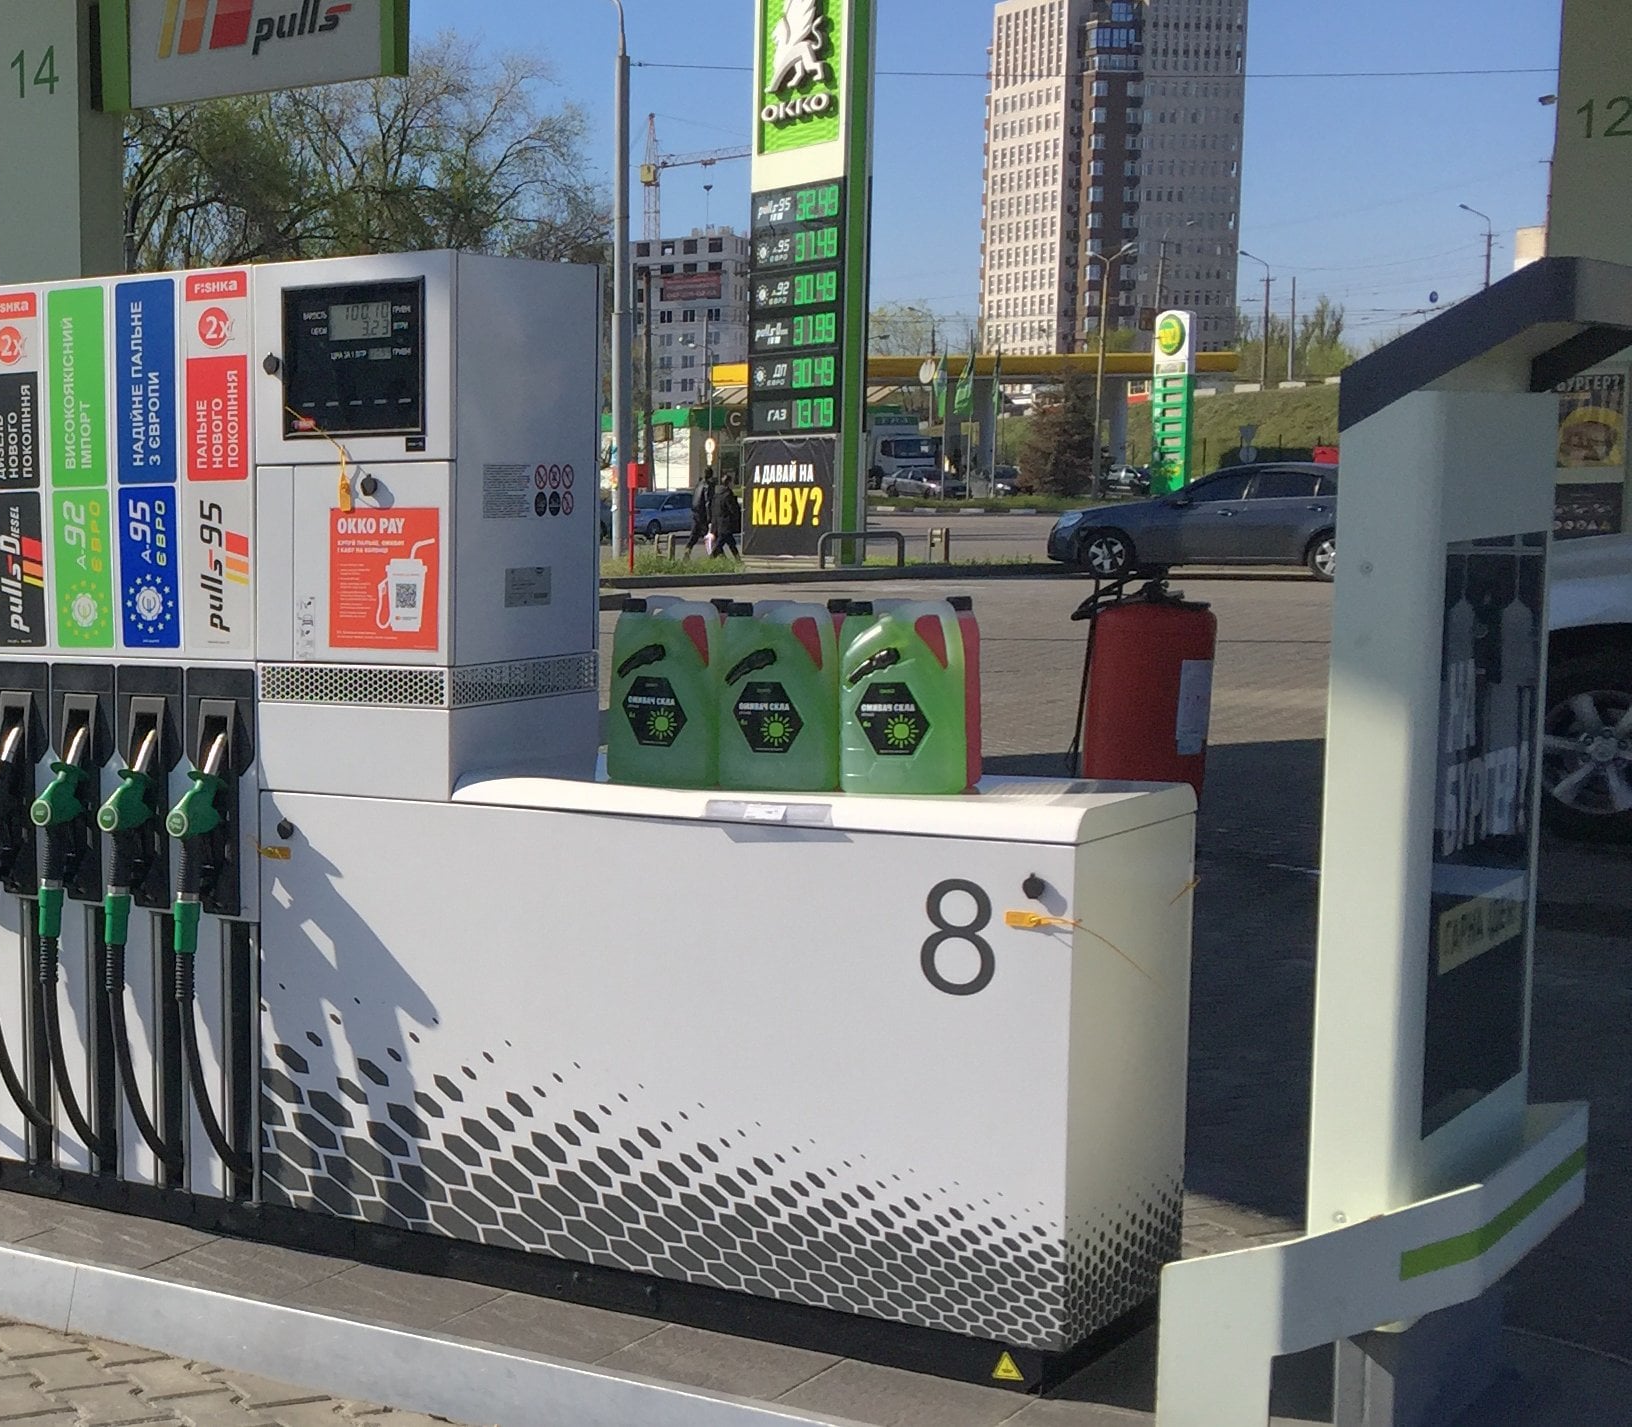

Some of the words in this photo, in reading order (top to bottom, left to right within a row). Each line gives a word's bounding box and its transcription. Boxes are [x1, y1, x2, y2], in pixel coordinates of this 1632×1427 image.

[11, 45, 59, 98] 14
[1577, 96, 1632, 138] 12
[795, 227, 838, 262] 31.49
[794, 271, 837, 305] 30.49
[130, 301, 143, 378] ПАЛЬНЕ
[793, 312, 836, 345] 31.99
[60, 317, 76, 470] ВИСОКОЯКІСНИЙ
[792, 356, 835, 388] 30.49
[20, 384, 33, 478] ПОКОЛІННЯ
[79, 401, 92, 469] ІМПОРТ
[130, 384, 145, 466] НАДІЙНЕ
[147, 371, 161, 448] ЄВРОПИ
[196, 400, 208, 469] ПАЛЬНЕ
[211, 398, 224, 469] НОВОГО
[226, 370, 239, 468] ПОКОЛІННЯ
[767, 409, 787, 422] ГАЗ
[7, 412, 19, 479] НОВОГО
[753, 465, 761, 483] А
[761, 460, 796, 485] ДАВАЙ
[799, 463, 814, 483] НА
[88, 500, 103, 573] ЄВРО
[154, 500, 167, 566] ЄВРО
[337, 518, 376, 534] OKKO
[379, 518, 405, 534] PAY
[752, 487, 823, 526] КАВУ?
[920, 878, 995, 996] 8
